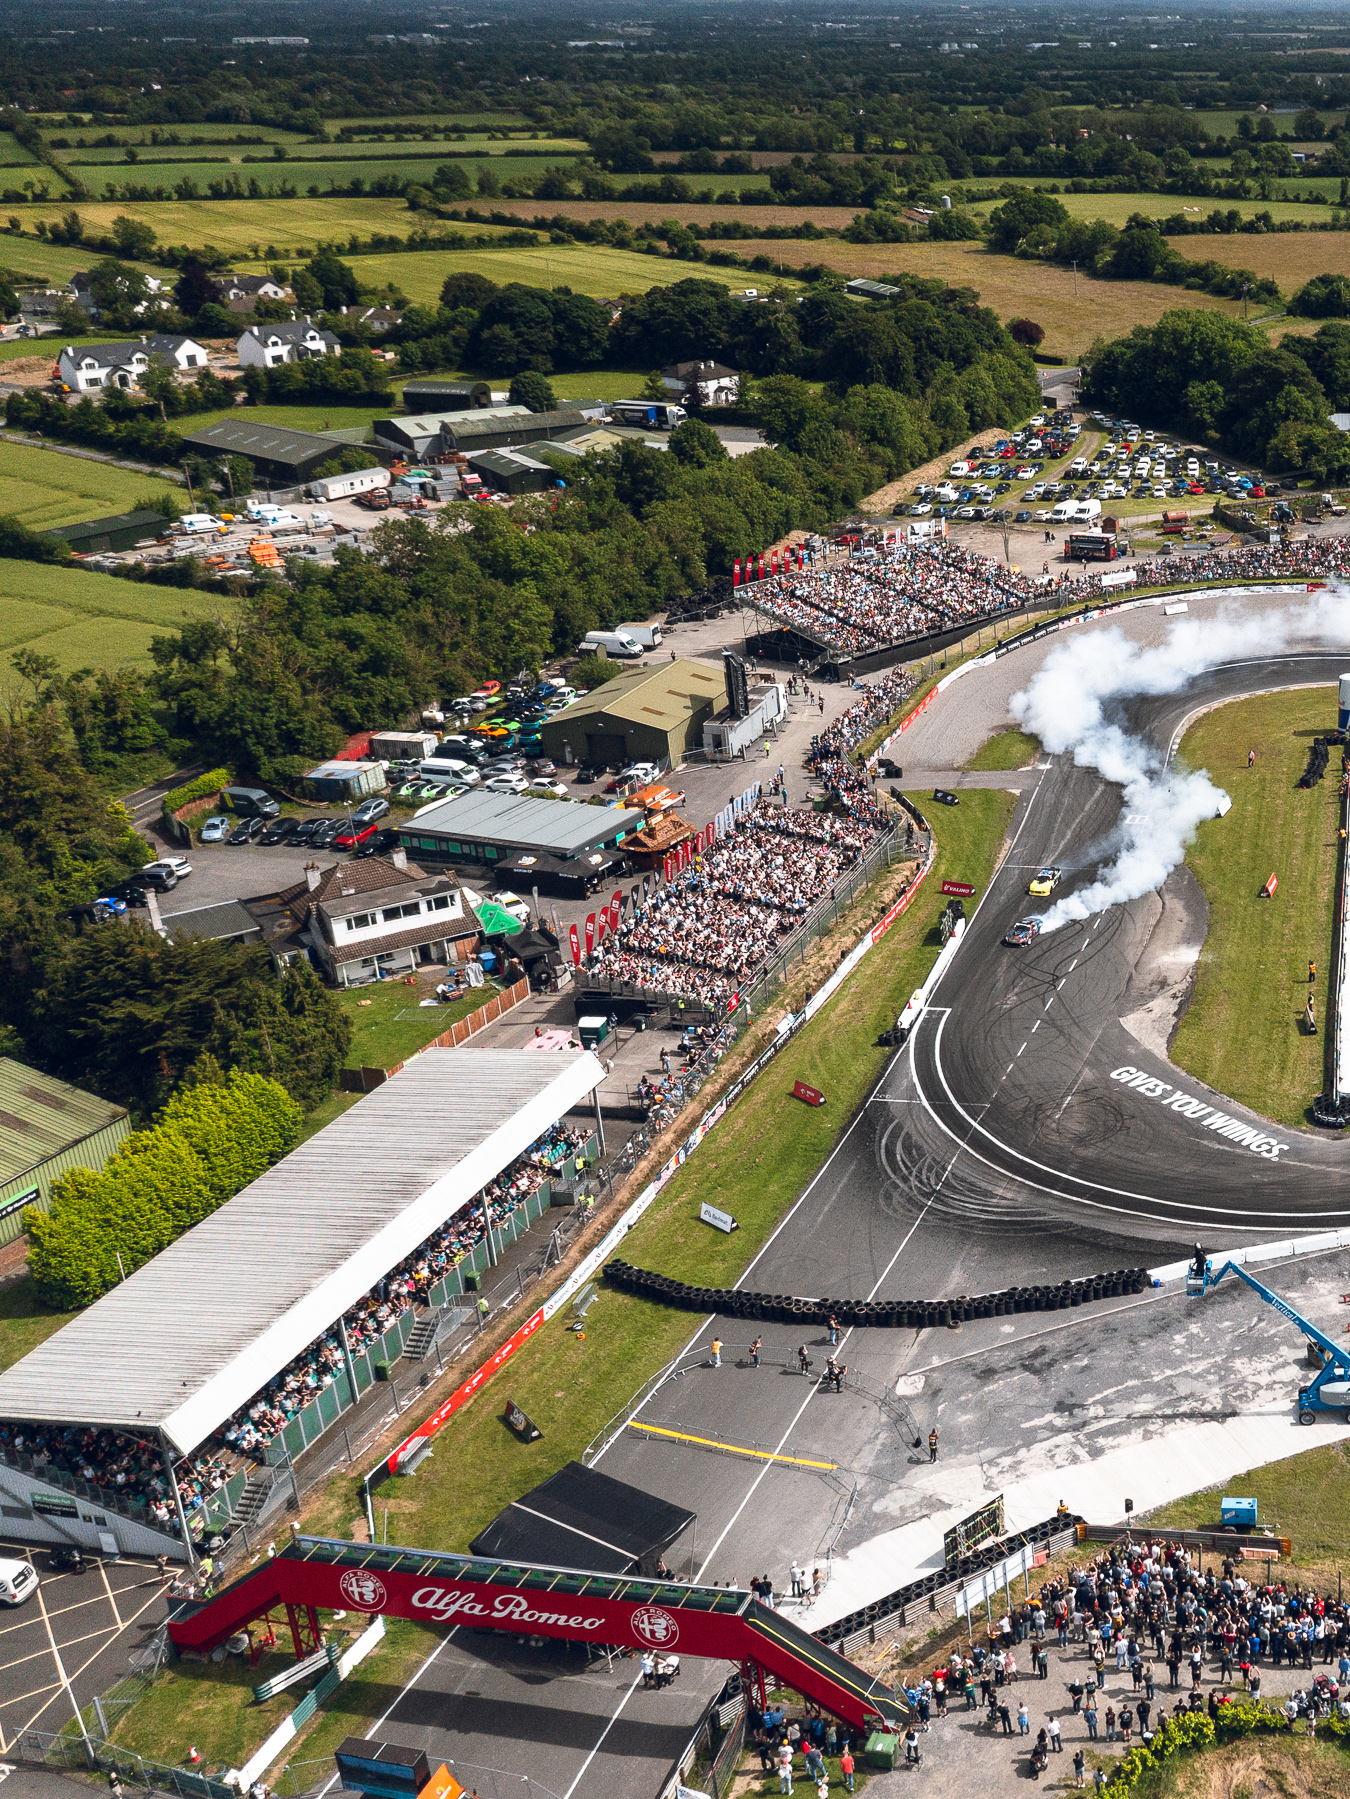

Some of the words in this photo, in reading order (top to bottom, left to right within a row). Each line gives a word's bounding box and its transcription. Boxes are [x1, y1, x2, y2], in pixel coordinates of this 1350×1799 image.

[1110, 1066, 1172, 1097] GIVES
[1161, 1090, 1214, 1118] YOU
[1272, 1298, 1297, 1320] Vertical
[342, 1573, 355, 1589] ALFA
[357, 1572, 384, 1593] ROMEO
[412, 1586, 490, 1620] Alfa
[493, 1594, 605, 1630] Romeo
[634, 1610, 647, 1625] ALFA
[650, 1609, 676, 1631] ROMEO
